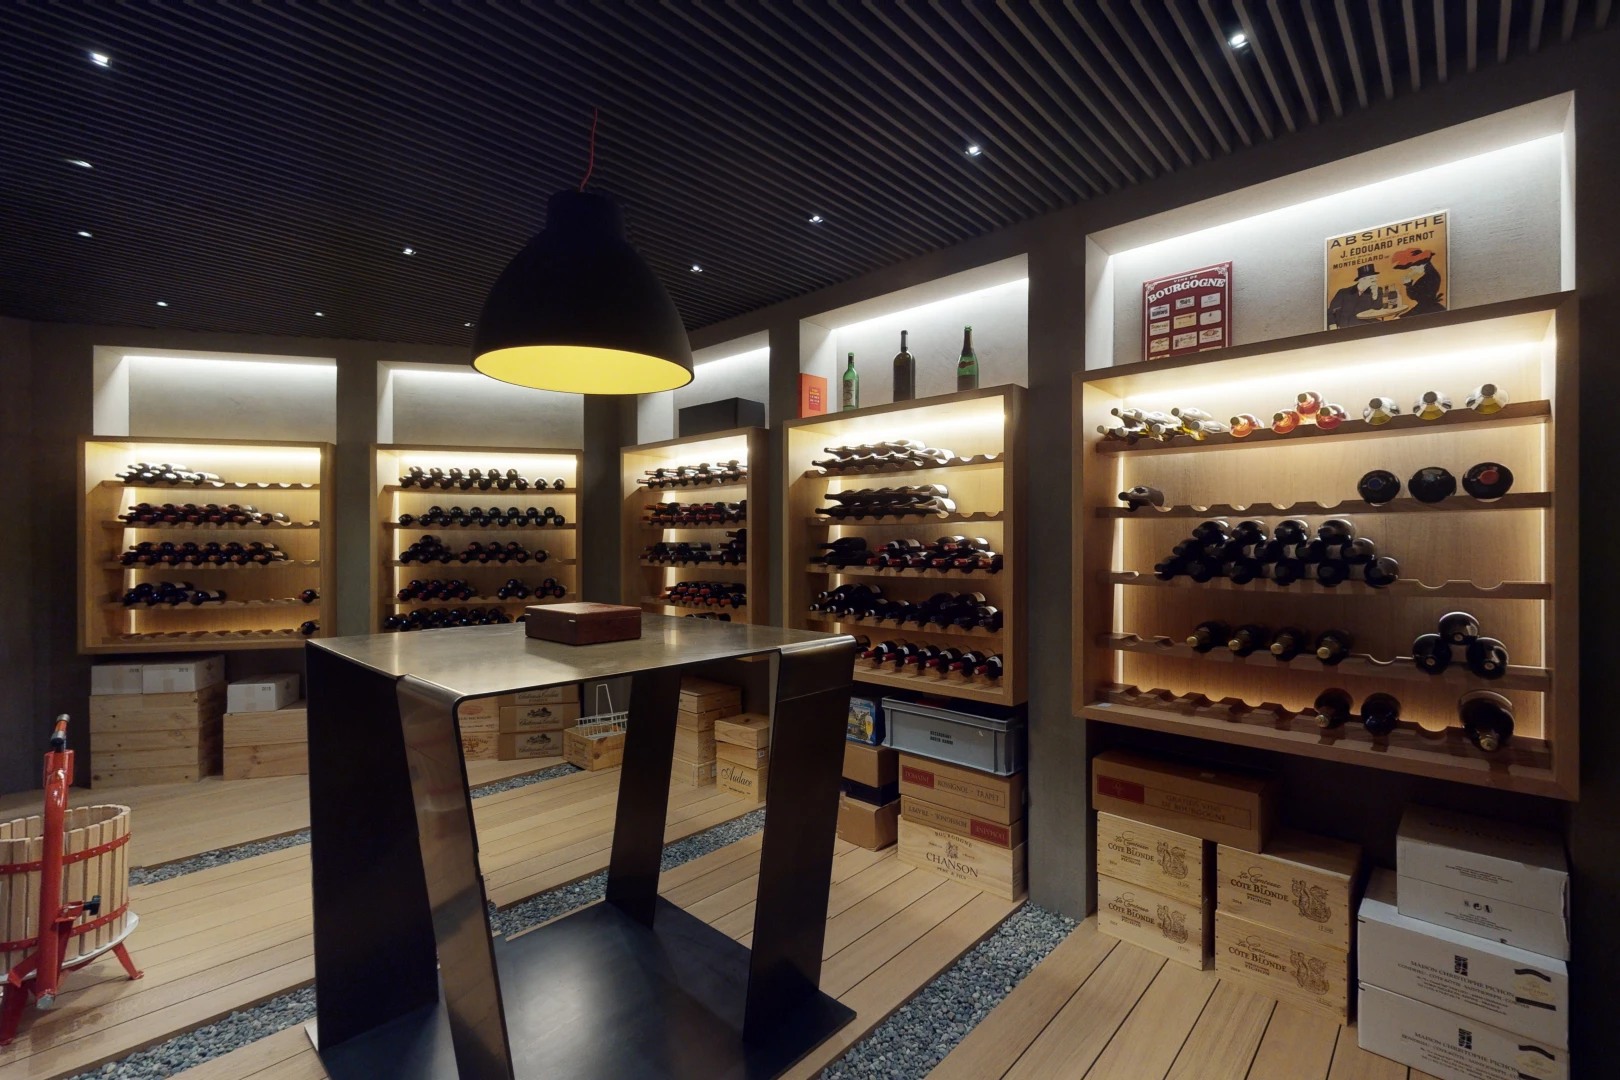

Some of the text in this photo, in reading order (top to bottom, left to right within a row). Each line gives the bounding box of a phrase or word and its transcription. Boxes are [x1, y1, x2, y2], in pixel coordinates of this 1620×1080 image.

[1330, 214, 1444, 249] ABSINTHE
[1340, 250, 1348, 258] J.
[1350, 240, 1393, 257] ÉDOUARD
[1397, 230, 1435, 246] PERNOT
[1147, 277, 1226, 303] BOURGOGNE
[721, 766, 752, 787] Audace
[905, 770, 929, 782] DOMAINE
[938, 780, 999, 802] ROSSIGNOL TRAPET
[1166, 794, 1221, 812] GRANDS VINS
[1174, 803, 1226, 820] BOURGOGNE
[908, 806, 967, 828] ROSSIGNOL TRAPET
[1108, 842, 1154, 862] CÔTE BLONDE
[926, 852, 978, 878] CHANSON
[1230, 878, 1288, 902] CÔTE BLONDE
[1108, 902, 1155, 924] CÔTE BLONDE
[1228, 946, 1287, 972] CÔTE BLONDE
[1410, 960, 1438, 972] MAISON
[1438, 970, 1484, 988] CHRISTOPHE
[1485, 984, 1515, 998] PICHON
[1414, 1032, 1442, 1045] MAISON
[1442, 1042, 1488, 1062] CHRISTOPHE
[1490, 1060, 1519, 1072] PICHON
